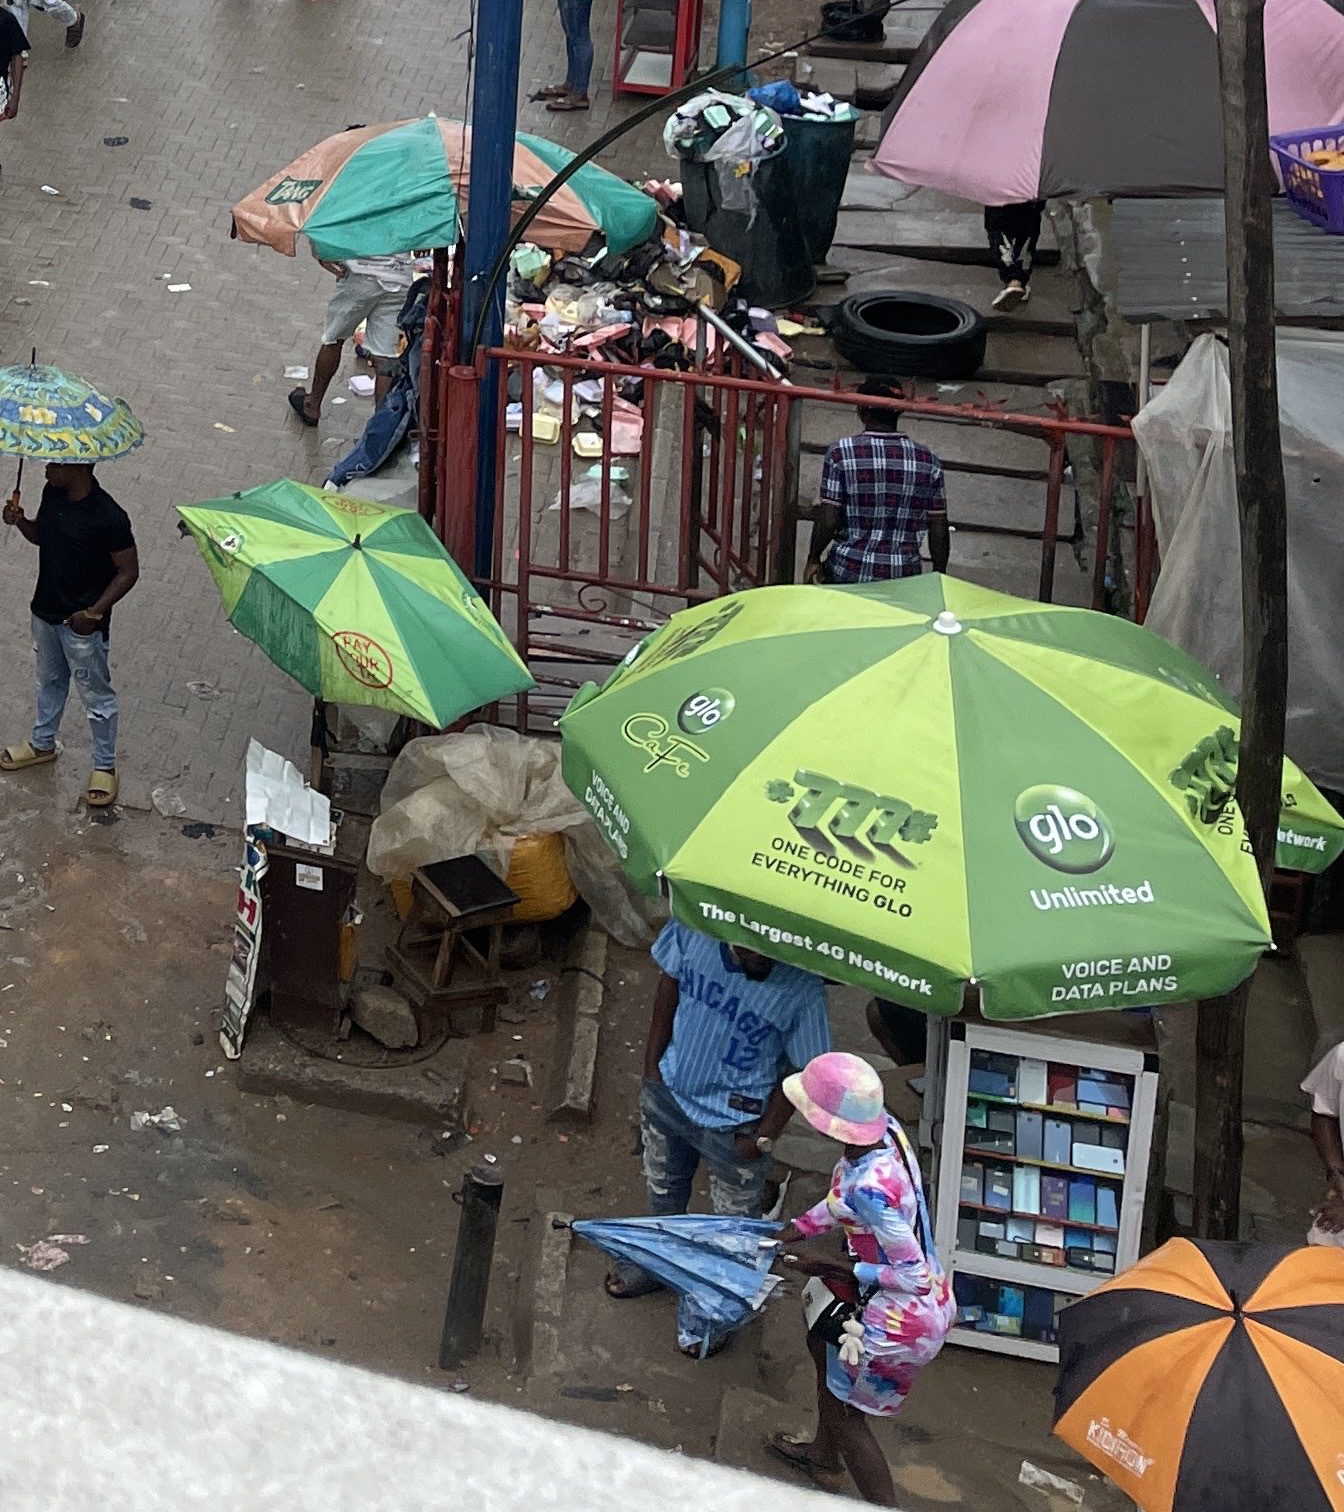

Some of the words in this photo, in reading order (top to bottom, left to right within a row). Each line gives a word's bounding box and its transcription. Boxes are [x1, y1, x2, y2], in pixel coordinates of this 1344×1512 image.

[683, 693, 722, 727] glo
[584, 784, 611, 827] DATA
[607, 820, 629, 861] PLANS
[590, 768, 617, 809] VOICE
[611, 803, 631, 836] AND
[1217, 803, 1236, 837] ONE
[1029, 804, 1100, 855] glo
[1276, 829, 1328, 852] etwork
[751, 851, 870, 904] EVERYTHING
[872, 894, 913, 919] GLO
[771, 836, 809, 862] ONE
[812, 847, 865, 880] CODE
[868, 869, 907, 894] FOR
[1029, 879, 1155, 912] Unlimited
[699, 900, 737, 924] The
[739, 913, 813, 951] Largest
[816, 940, 845, 961] 4G
[848, 949, 932, 997] Network
[1061, 957, 1124, 980] VOICE
[1126, 954, 1172, 973] AND
[1051, 979, 1105, 1002] DATA
[1108, 976, 1178, 998] PLANS
